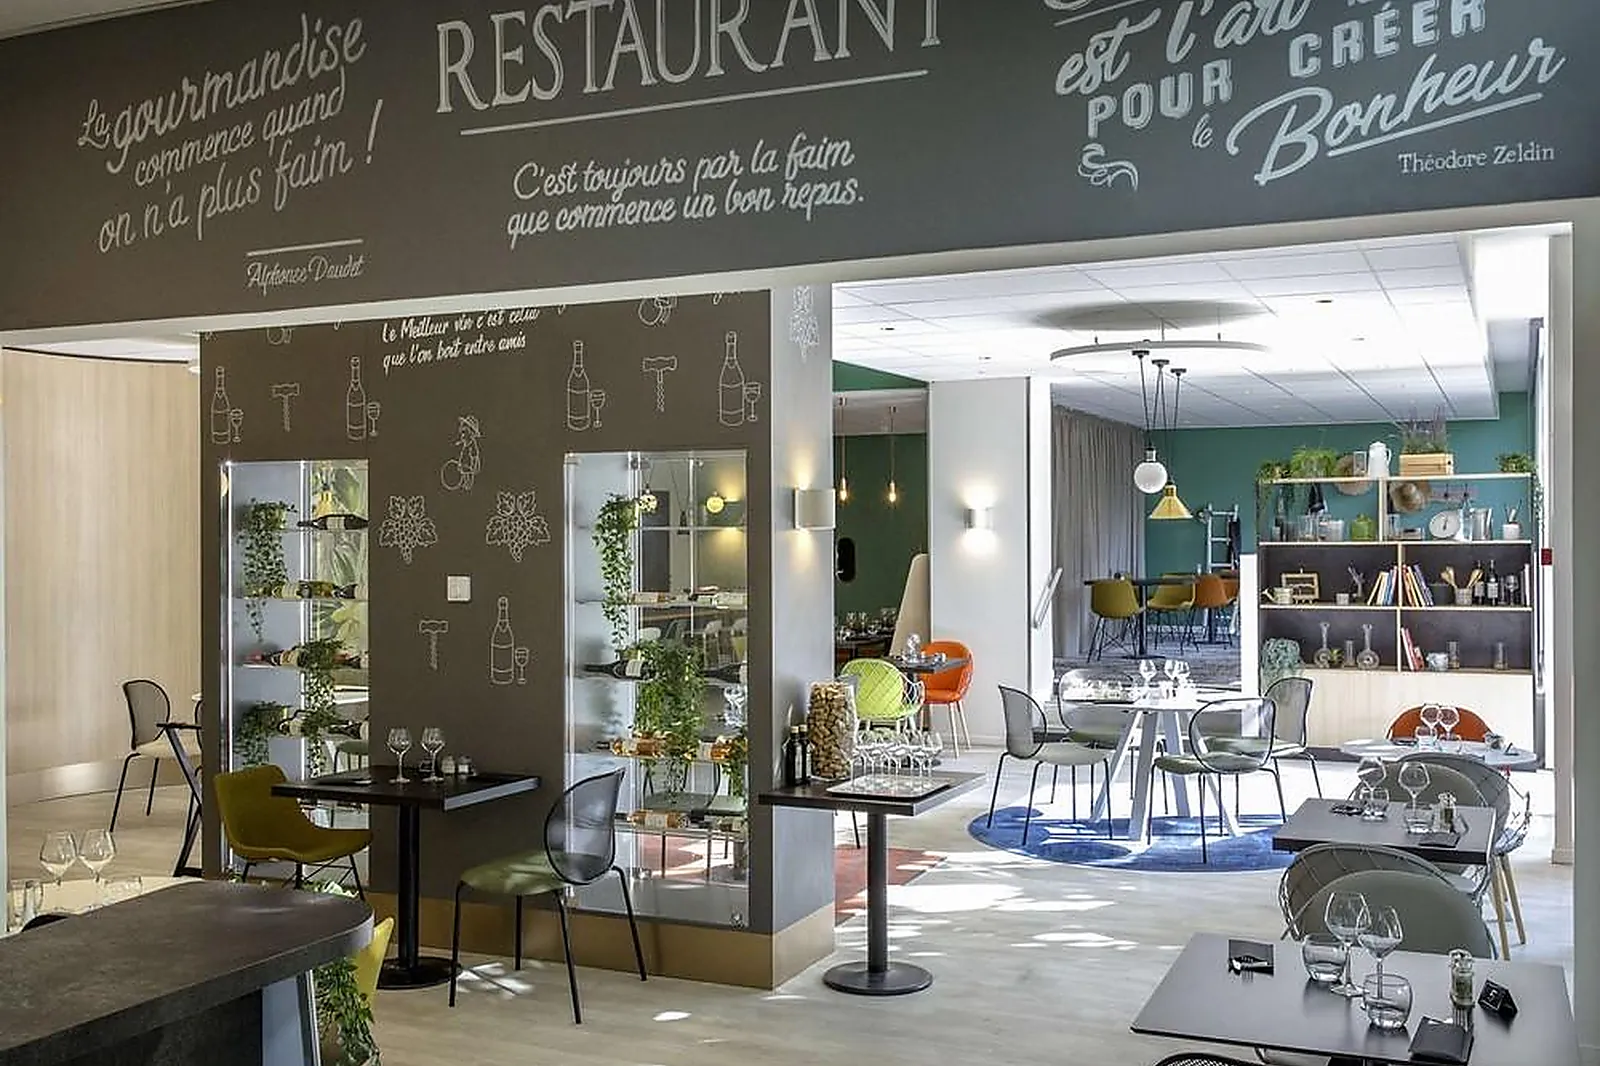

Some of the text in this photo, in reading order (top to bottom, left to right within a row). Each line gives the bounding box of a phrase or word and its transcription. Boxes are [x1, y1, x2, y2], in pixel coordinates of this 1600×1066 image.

[1055, 8, 1162, 95] est
[1087, 0, 1486, 139] POUR CRÉER
[77, 12, 367, 173] La gourmandise
[135, 66, 346, 187] commence quand
[1192, 37, 1566, 186] le Bonheur
[98, 211, 136, 254] on
[144, 180, 191, 239] n'a
[197, 162, 263, 241] plus
[274, 135, 354, 212] faim
[513, 131, 855, 201] C'est toujours par la faim
[1398, 142, 1555, 174] Théodore Zeldin
[506, 177, 865, 250] que commence un bon repas.
[308, 255, 364, 281] Daudet
[382, 322, 397, 343] Le
[383, 352, 406, 376] que
[498, 330, 526, 350] amis
